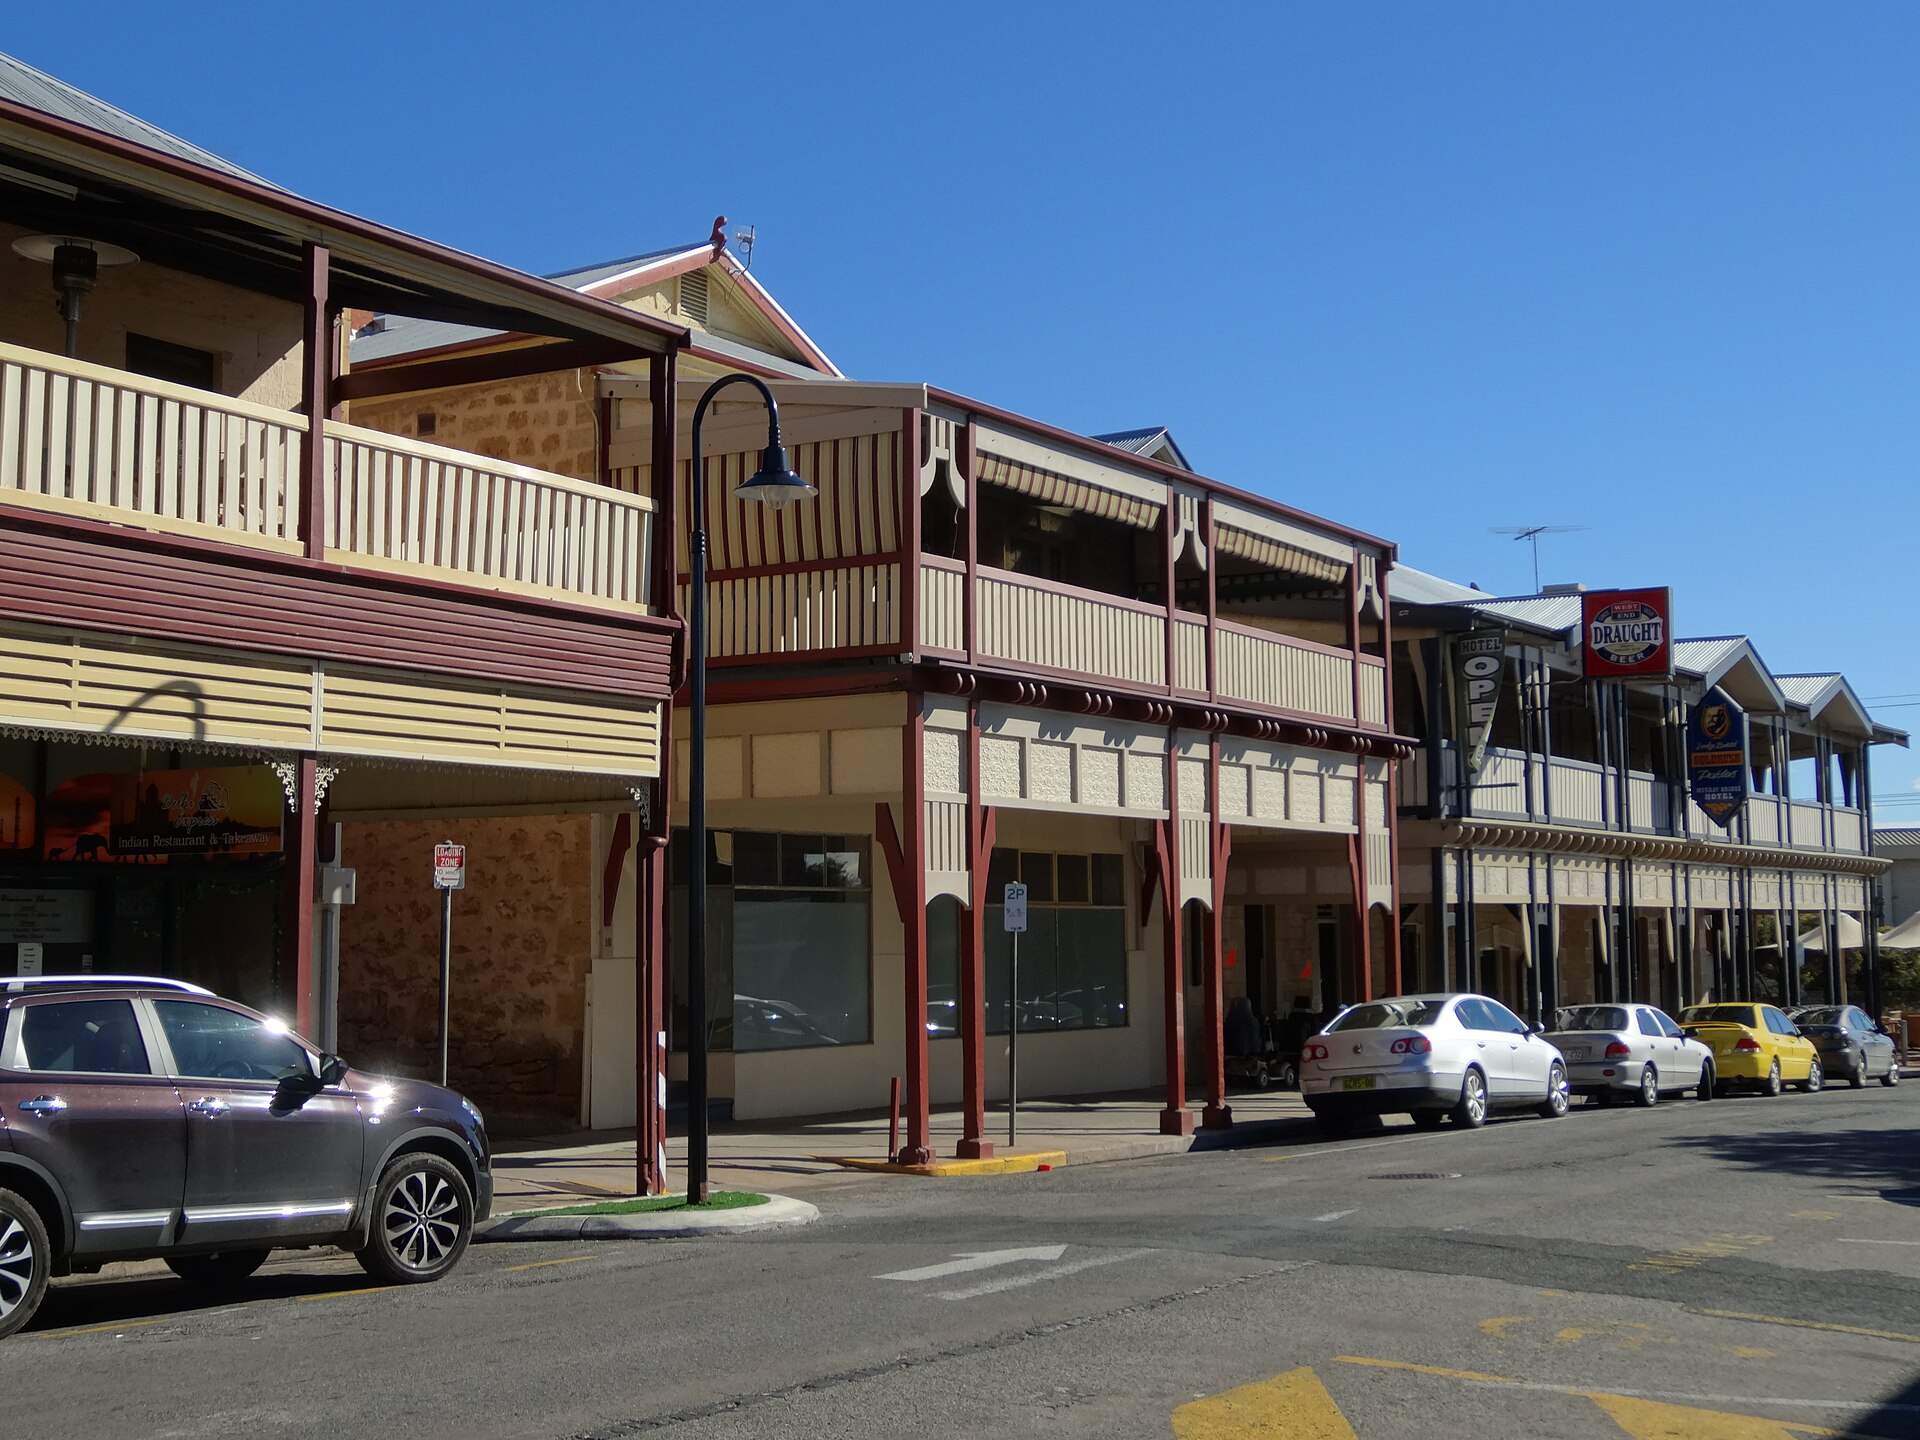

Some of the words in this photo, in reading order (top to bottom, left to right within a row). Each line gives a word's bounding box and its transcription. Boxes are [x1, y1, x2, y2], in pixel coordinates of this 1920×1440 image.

[1594, 622, 1661, 644] DRAUGHT
[1462, 638, 1501, 654] HOTEL
[1610, 653, 1645, 663] BEER
[118, 835, 149, 848] Indian
[153, 833, 205, 847] Restaurant
[209, 833, 219, 845] &
[223, 831, 271, 846] Takeaway
[438, 848, 462, 857] LOADING
[440, 858, 459, 867] ZONE
[1007, 888, 1025, 900] 2P
